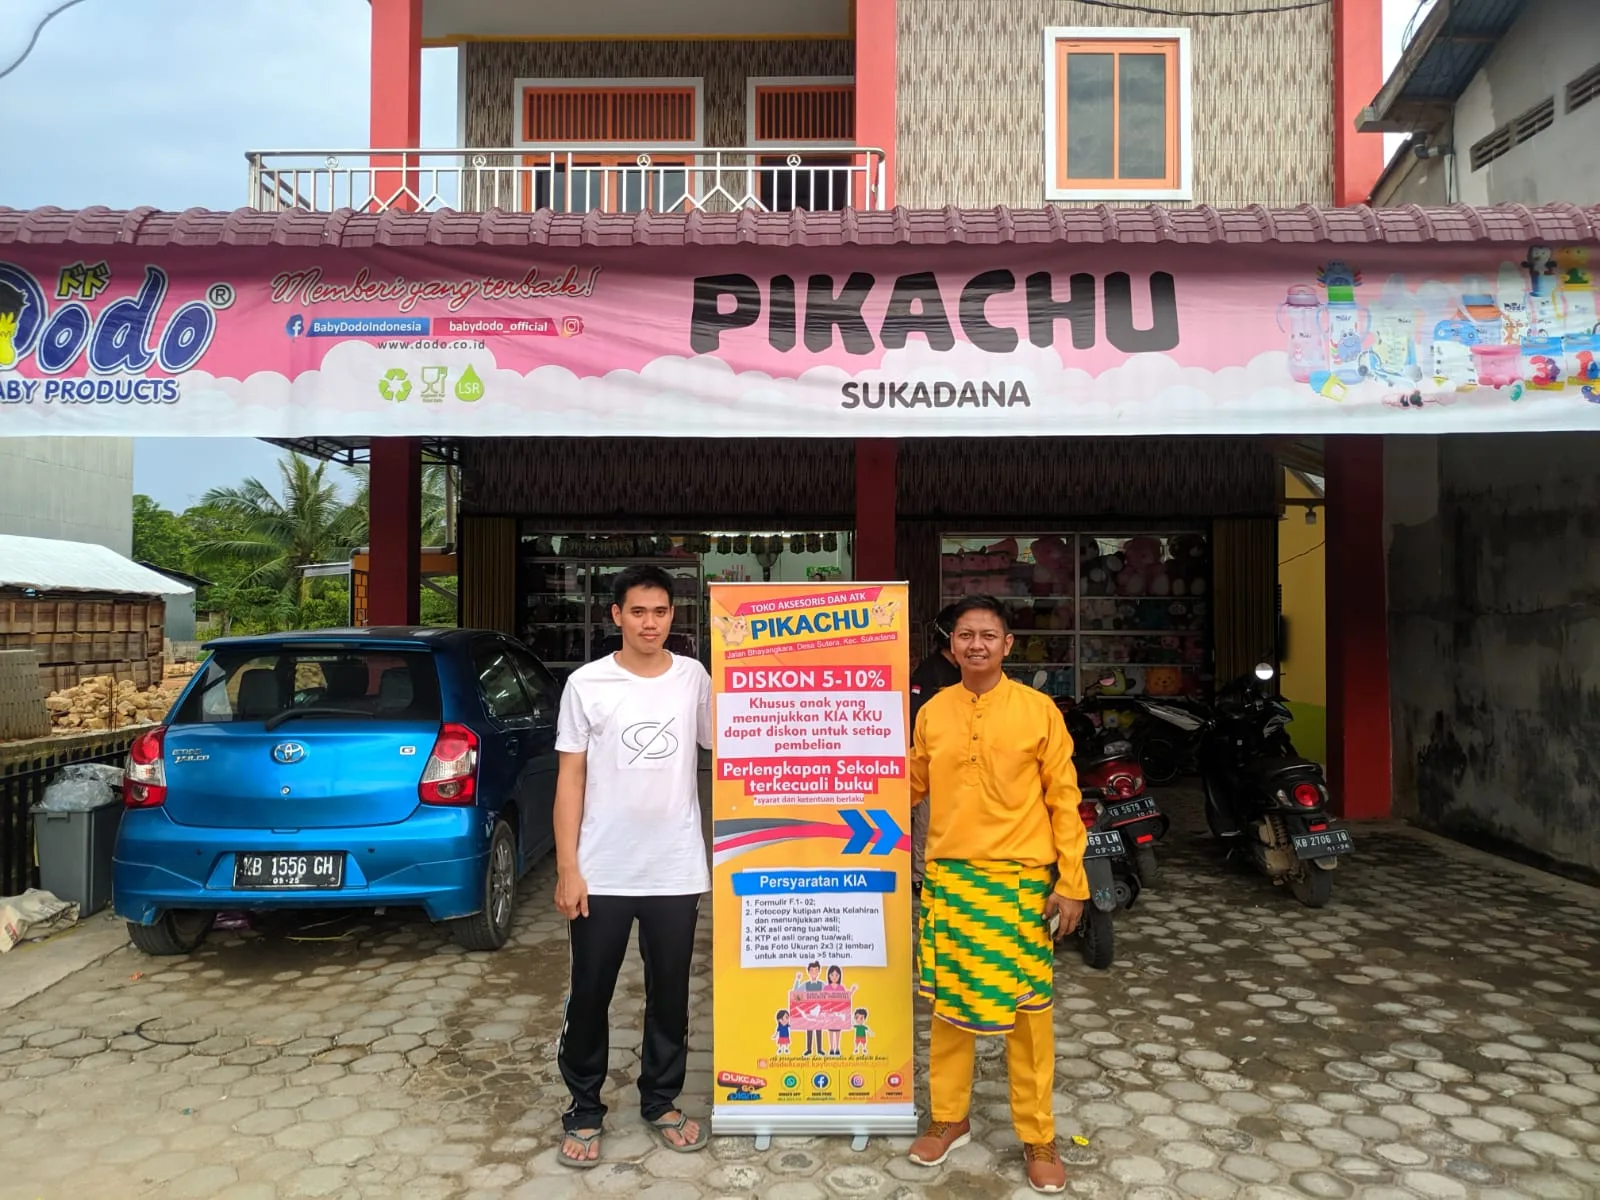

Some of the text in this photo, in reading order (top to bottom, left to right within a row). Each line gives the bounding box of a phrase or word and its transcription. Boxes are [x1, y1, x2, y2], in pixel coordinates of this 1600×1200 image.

[272, 266, 599, 312] Memberi yang terbaik!
[690, 269, 1181, 354] PIKACHU
[312, 315, 422, 334] BabyDodoIndonesia
[448, 313, 548, 334] babydodo_official
[377, 338, 486, 351] www.dodo.co.id
[45, 379, 178, 401] PRODUCTS
[458, 381, 480, 394] LSR
[841, 380, 1031, 409] SUKADANA
[751, 592, 866, 614] TOKO AKSESORIS DAN ATK
[751, 608, 870, 641] PIKACHU
[732, 670, 885, 689] DISKON 5-10%
[749, 696, 866, 710] Khusus anak yang
[732, 710, 883, 726] menunjukkan KIA KKU
[724, 724, 891, 739] dapat diskon untuk setiap
[774, 738, 841, 752] pembelian
[723, 760, 900, 779] Perlengkapan Sekolah
[749, 776, 873, 792] terkecuali buku
[271, 856, 307, 876] 1556
[313, 855, 334, 875] GH
[760, 874, 868, 890] Persyaratan KIA
[754, 908, 791, 916] Fotocopy
[792, 906, 821, 915] kutipan
[842, 906, 879, 914] Kelahiran
[771, 916, 823, 925] menunjukkan
[797, 935, 820, 943] orang
